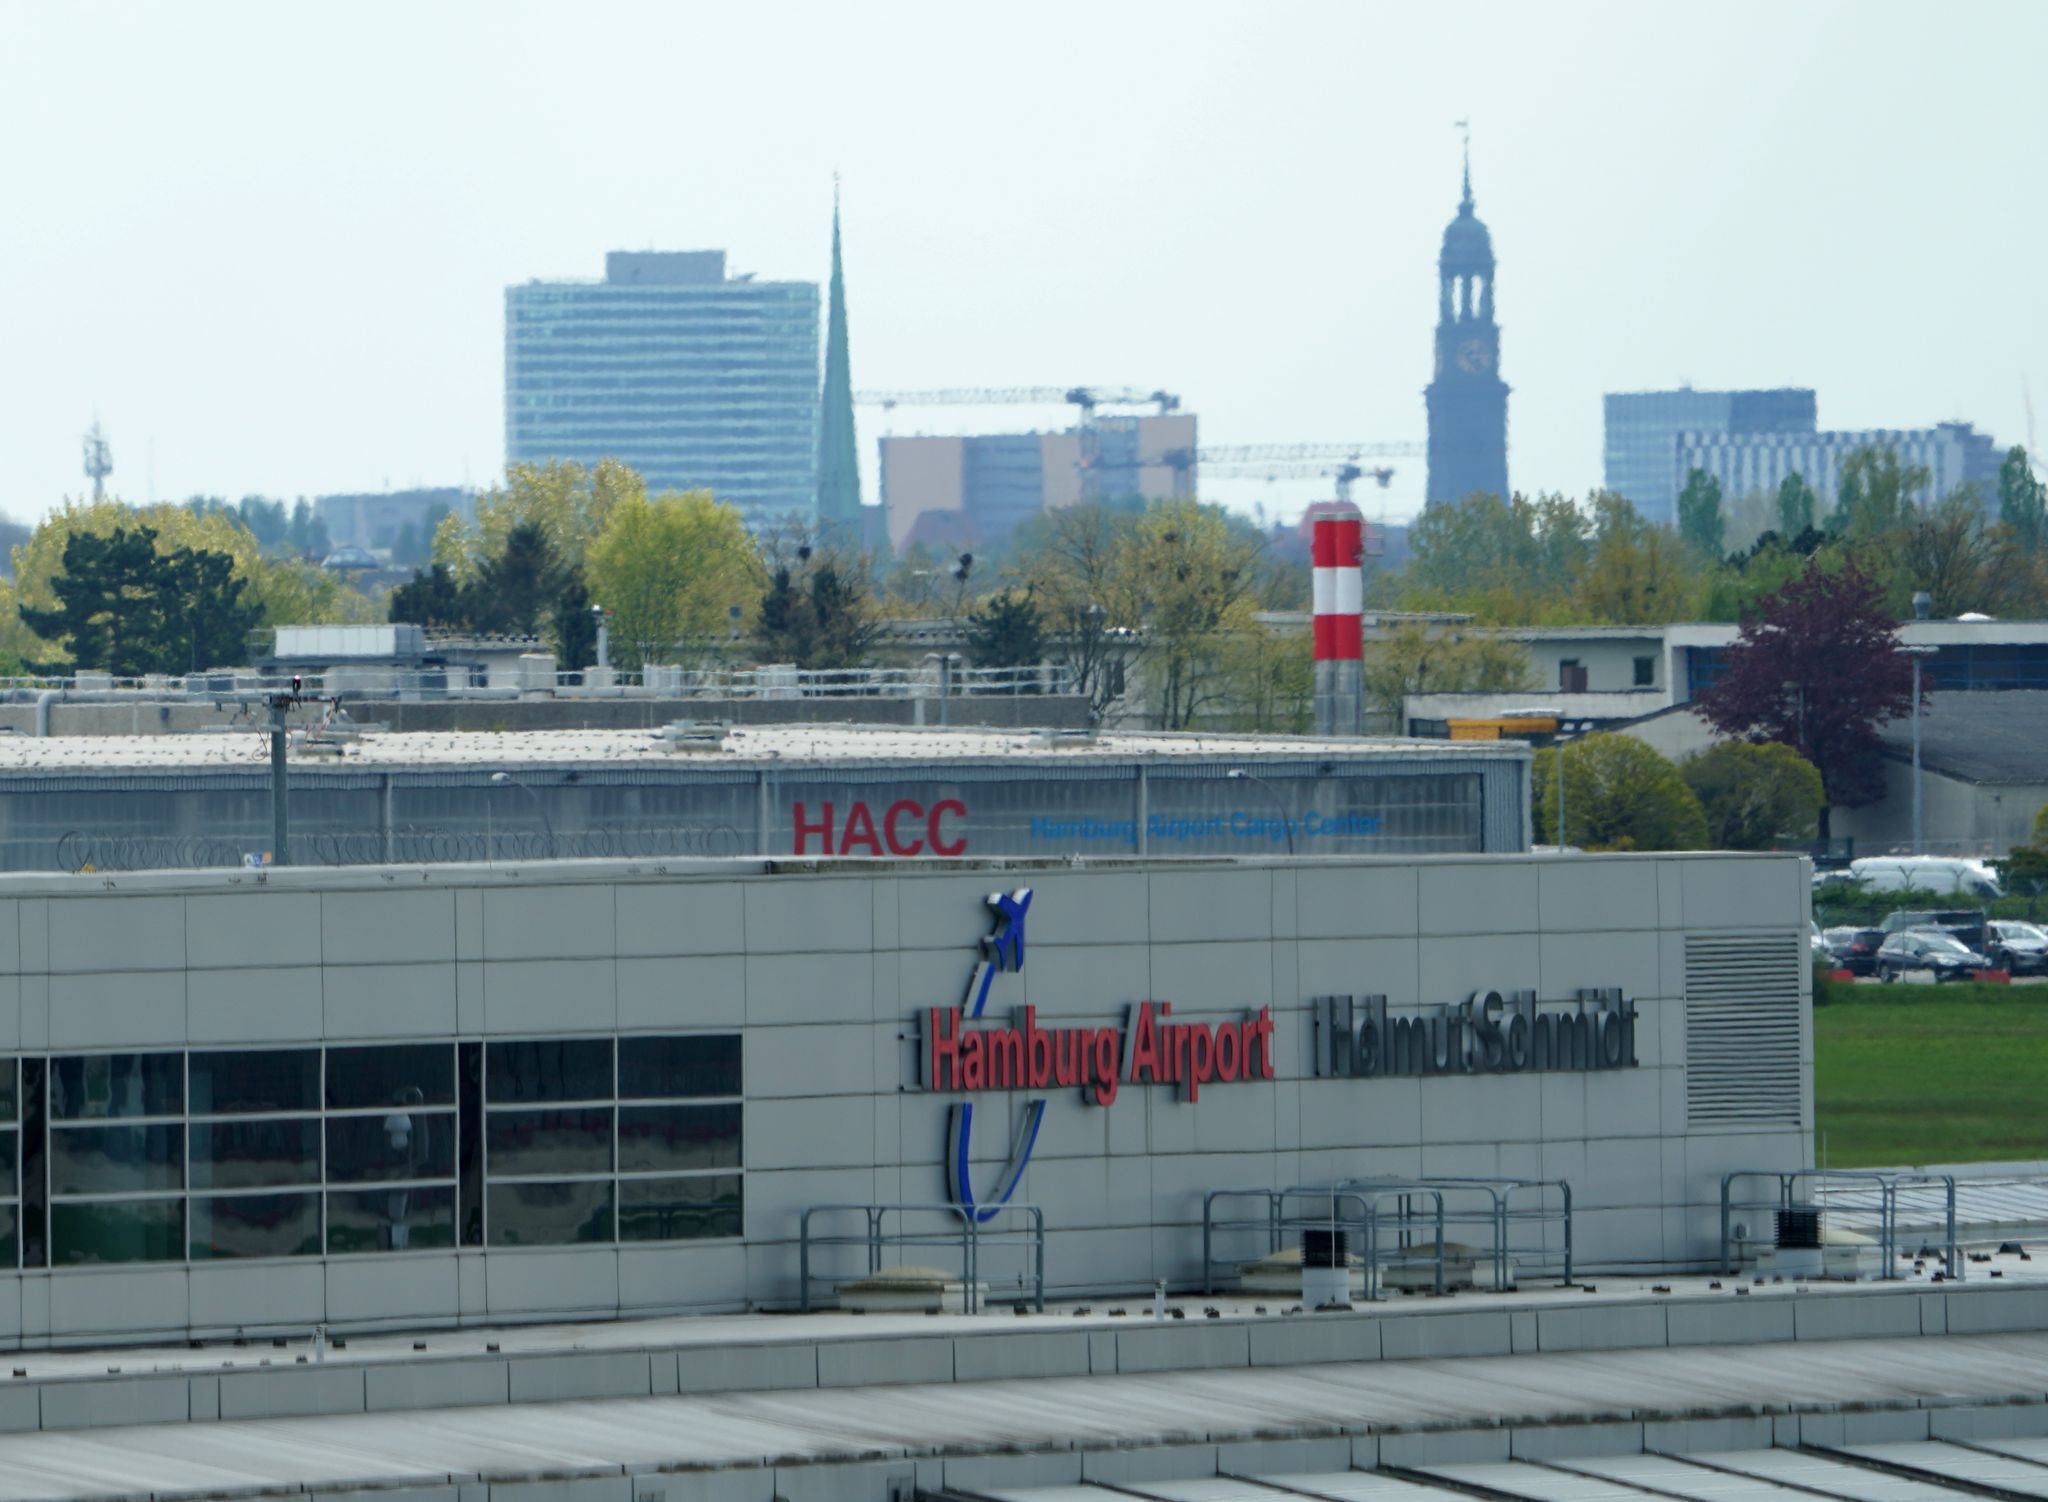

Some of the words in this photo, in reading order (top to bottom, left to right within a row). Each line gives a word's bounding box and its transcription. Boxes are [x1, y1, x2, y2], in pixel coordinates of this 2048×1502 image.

[793, 798, 967, 856] HACC
[1030, 814, 1138, 843] Hamburg
[1146, 814, 1222, 840] Airport
[1230, 811, 1298, 840] Cargo
[1304, 809, 1381, 835] Center
[928, 1005, 1118, 1106] Hamburg
[1131, 1000, 1274, 1104] Airport
[1314, 995, 1473, 1076] Helmut
[1472, 988, 1636, 1073] Schmidt
